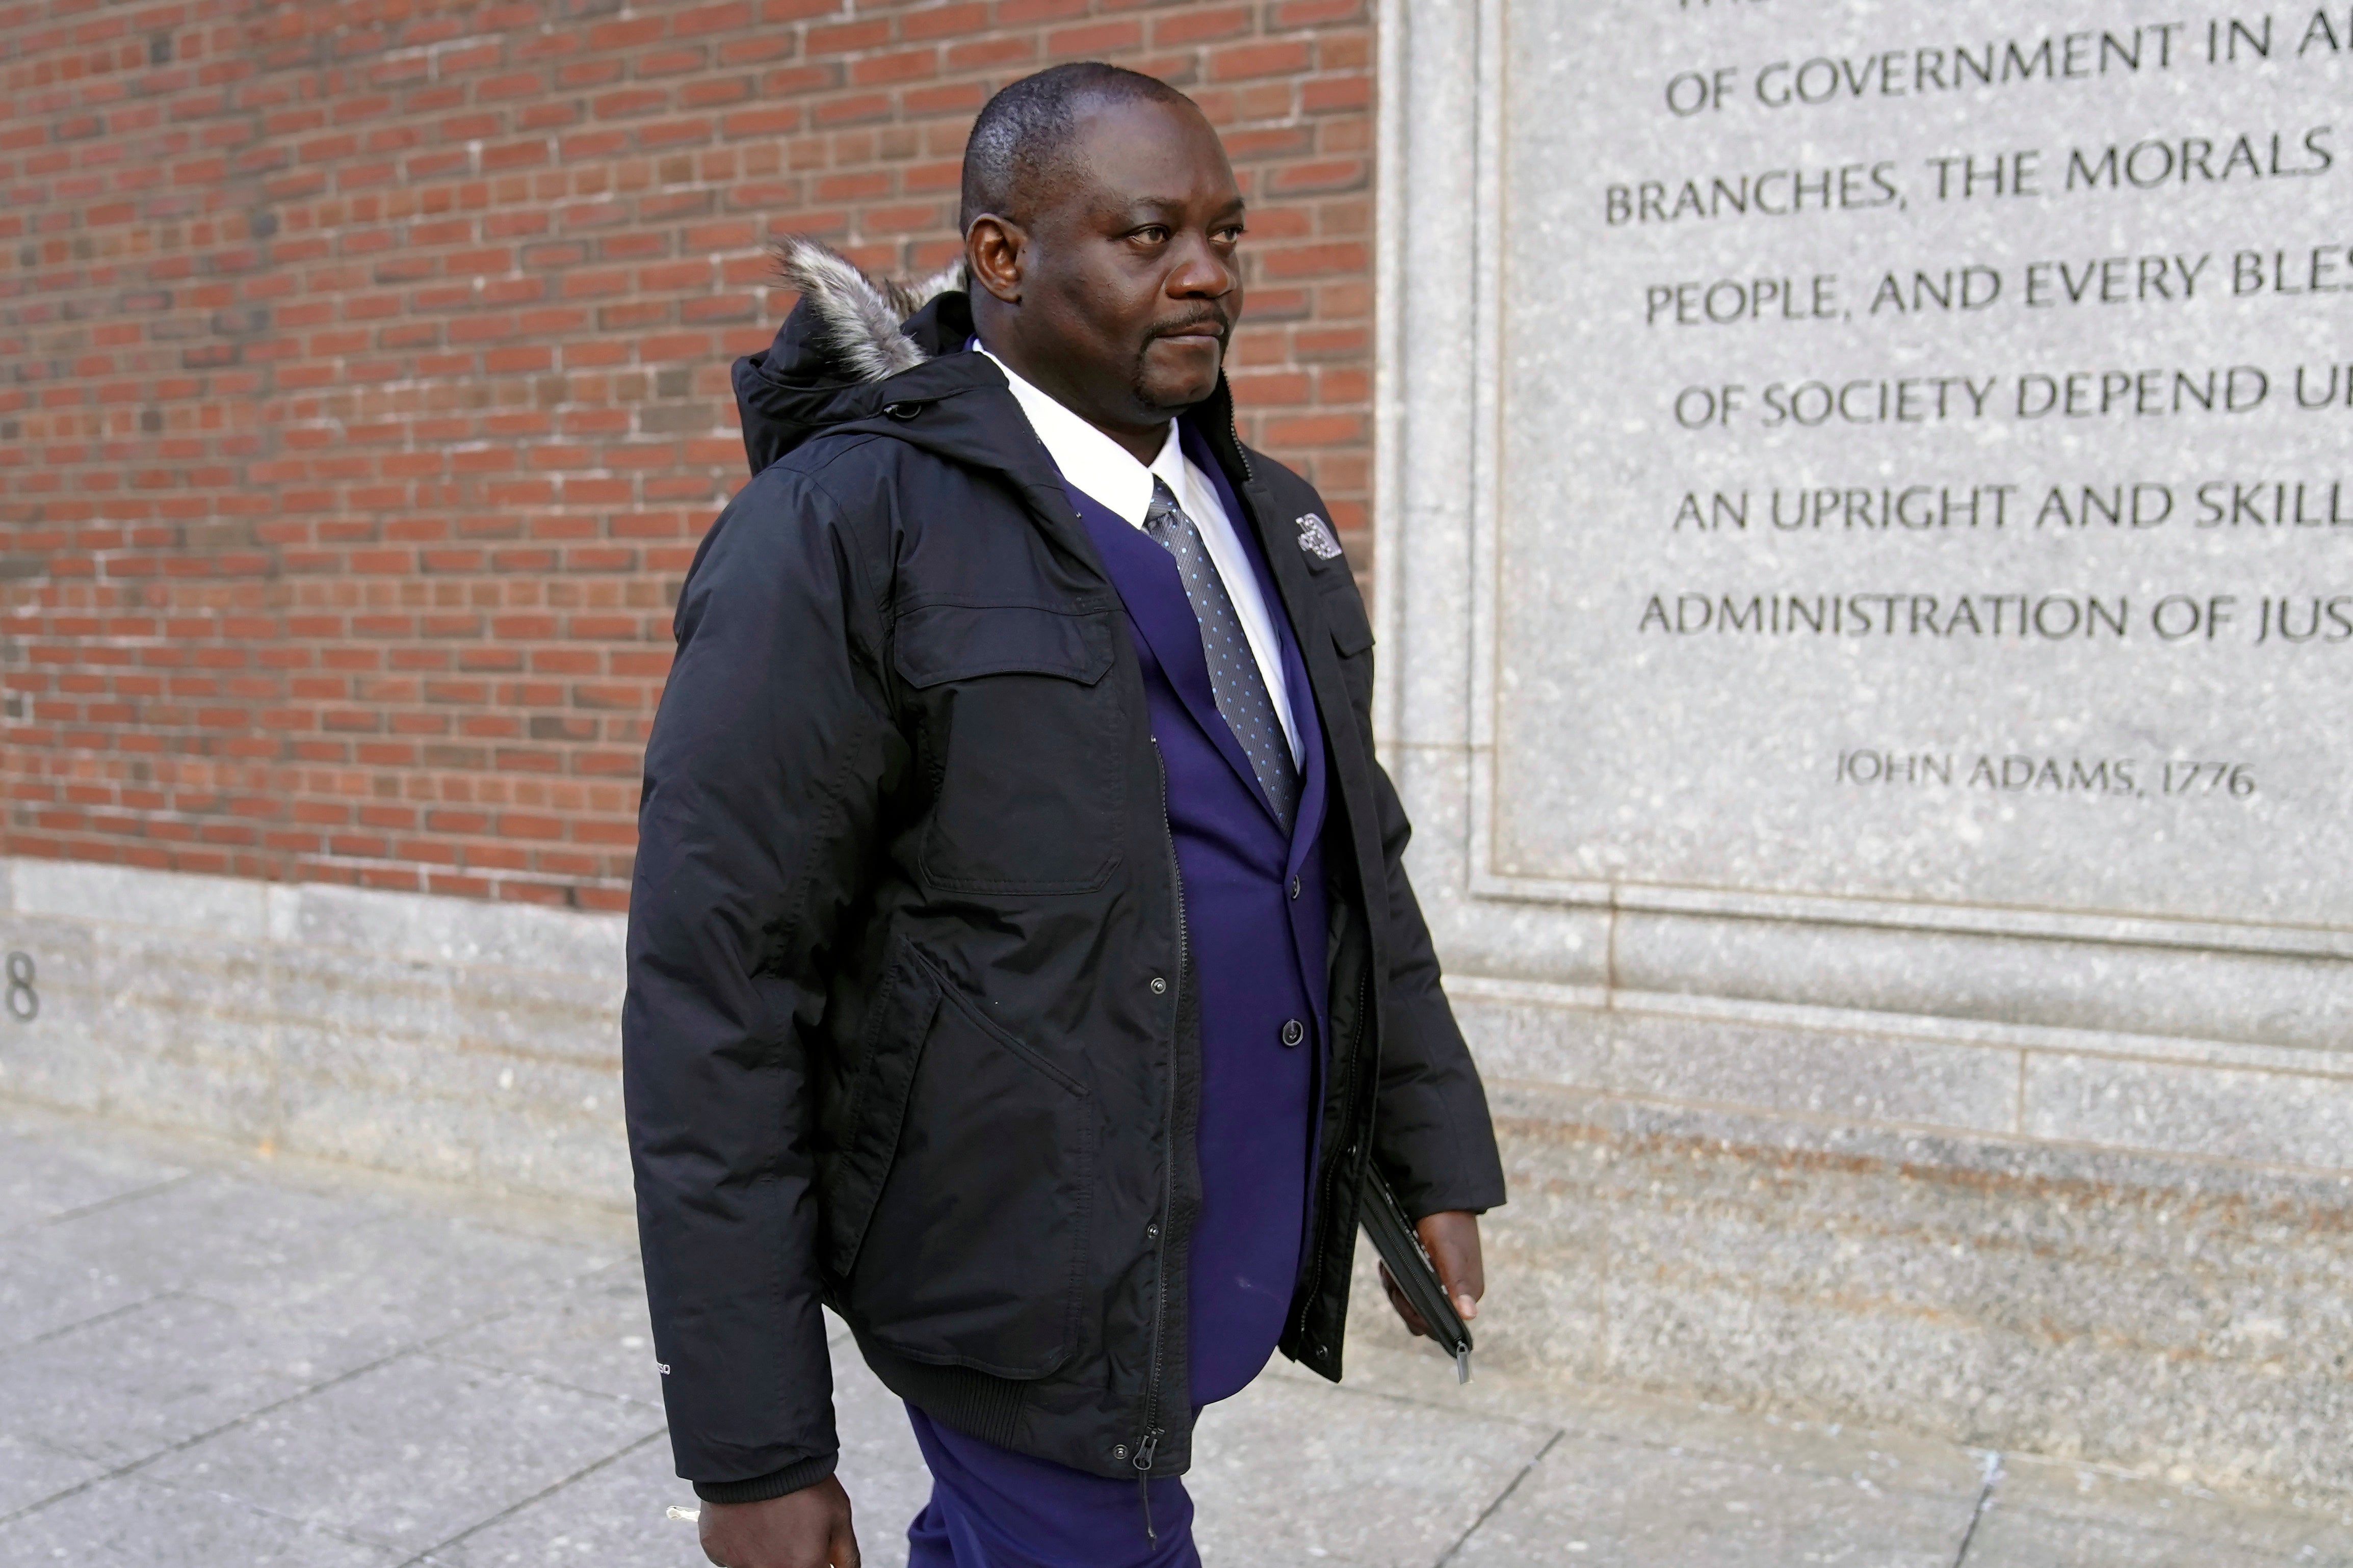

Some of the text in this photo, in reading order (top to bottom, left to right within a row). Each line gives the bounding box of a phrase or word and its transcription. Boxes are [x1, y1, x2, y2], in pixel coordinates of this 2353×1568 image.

[1664, 7, 2353, 118] OF GOVERNMENT IN A
[1605, 125, 2334, 227] BRANCHES, THE MORALS
[1645, 245, 2353, 328] PEOPLE, AND EVERY BLE
[1673, 362, 2353, 430] OF SOCIETY DEPEND U
[1672, 479, 2353, 533] AN UPRIGHT AND SKILL
[1637, 593, 2353, 646] ADMINISTRATION OF JUS
[1836, 749, 2257, 799] JOHN ADAMS, 1776
[6, 951, 39, 1022] 8
